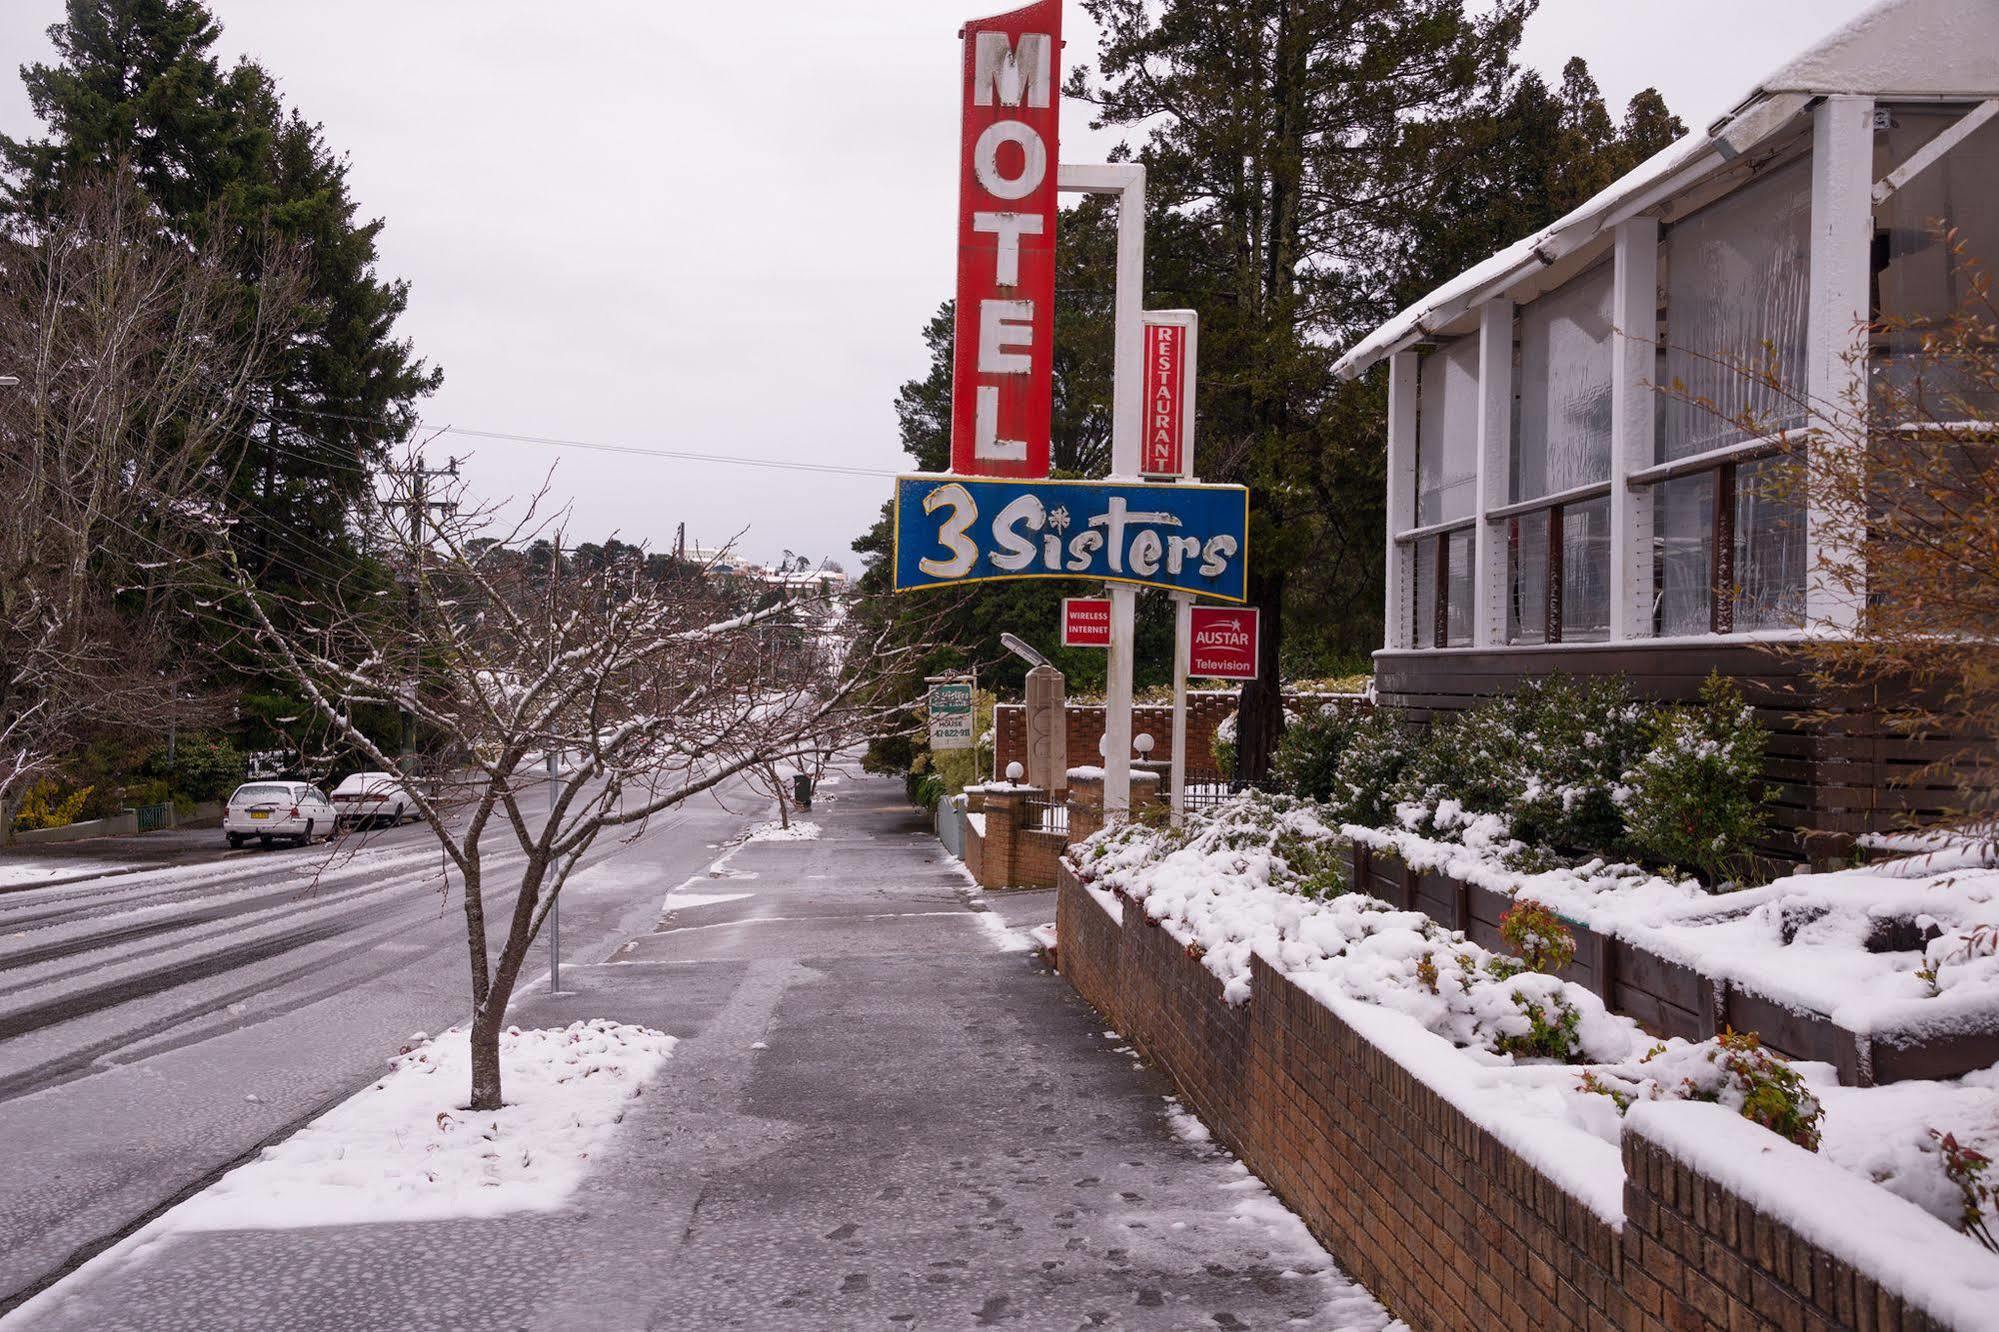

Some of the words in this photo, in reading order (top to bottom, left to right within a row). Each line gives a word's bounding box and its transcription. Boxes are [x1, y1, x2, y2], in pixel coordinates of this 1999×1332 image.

[973, 31, 1051, 461] MOTEL
[1154, 327, 1173, 472] RESTAURANT
[918, 483, 979, 578] 3
[988, 493, 1238, 577] Sisters
[1069, 611, 1108, 621] WIRELESS
[1068, 625, 1108, 634] INTERNET
[1195, 631, 1249, 646] AUSTAR
[1195, 658, 1250, 671] Television
